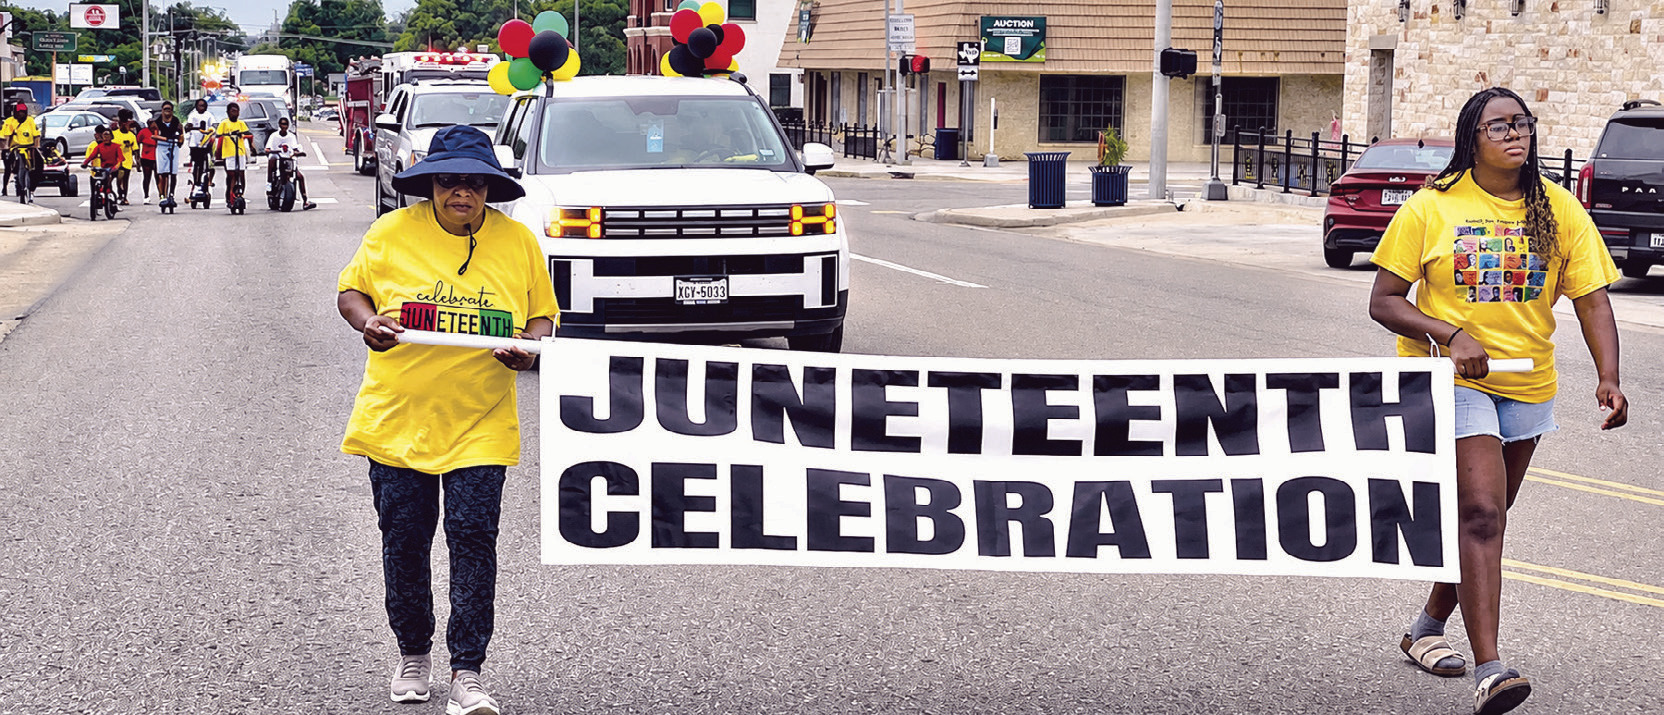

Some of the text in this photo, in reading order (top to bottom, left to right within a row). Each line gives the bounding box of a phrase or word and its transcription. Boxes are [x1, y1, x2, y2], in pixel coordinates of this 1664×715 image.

[993, 19, 1034, 28] AUCTION
[416, 280, 495, 308] celebrate
[400, 306, 512, 338] JUNETEENTH
[559, 355, 1437, 457] JUNETEENTH
[558, 460, 1444, 568] CELEBRATION
